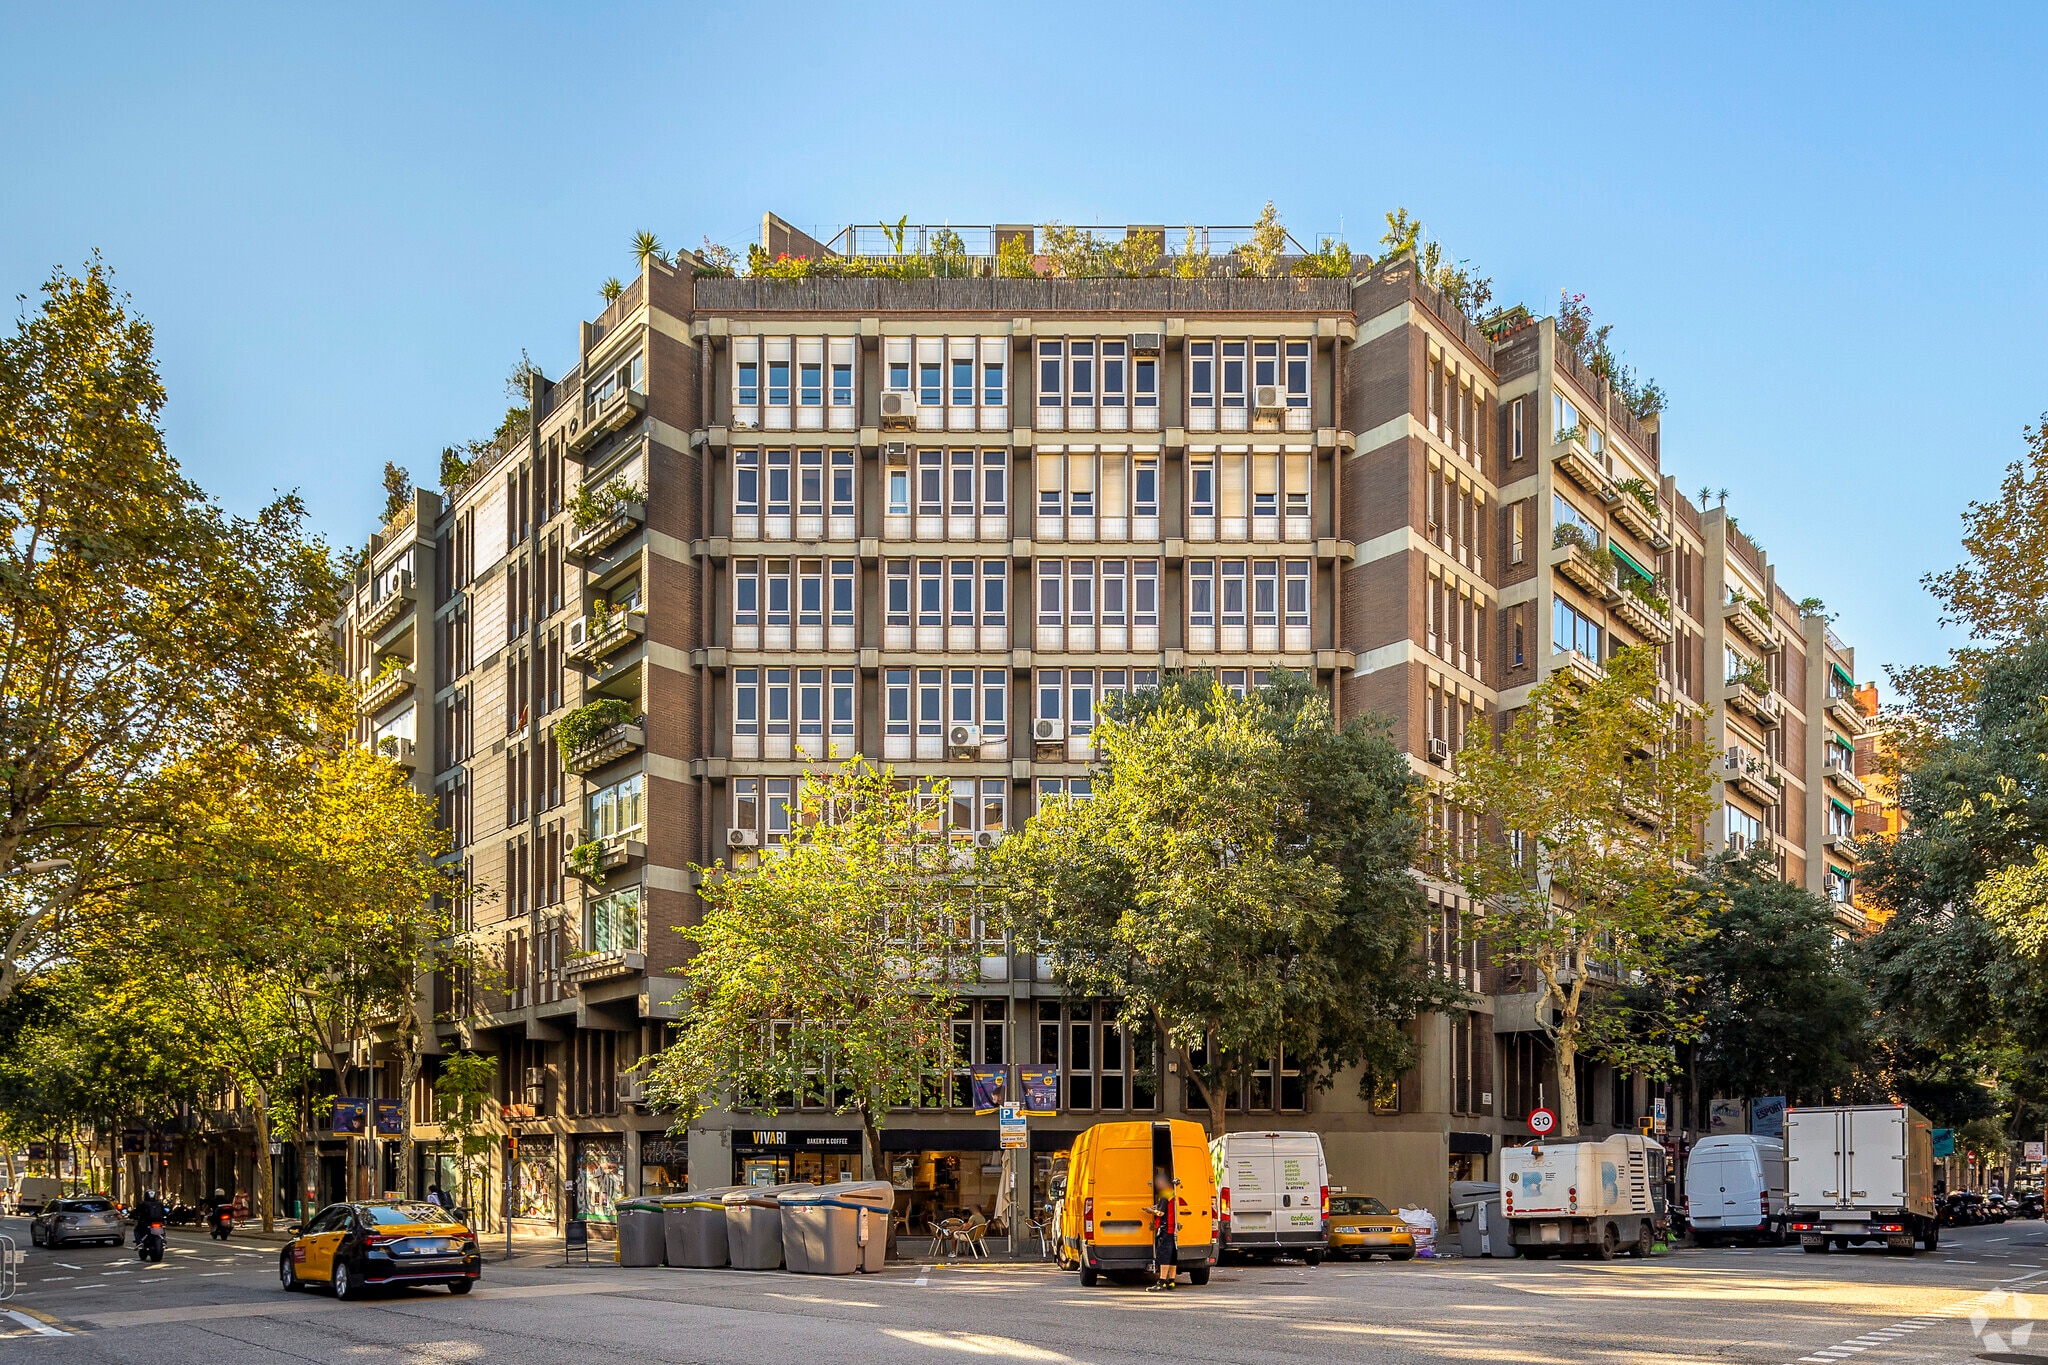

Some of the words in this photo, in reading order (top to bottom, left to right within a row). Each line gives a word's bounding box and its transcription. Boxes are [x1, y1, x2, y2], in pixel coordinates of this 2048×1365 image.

[1003, 1109, 1011, 1119] P
[1755, 1102, 1783, 1120] ESPORT
[1534, 1116, 1550, 1126] 30
[753, 1131, 786, 1144] VIVARI
